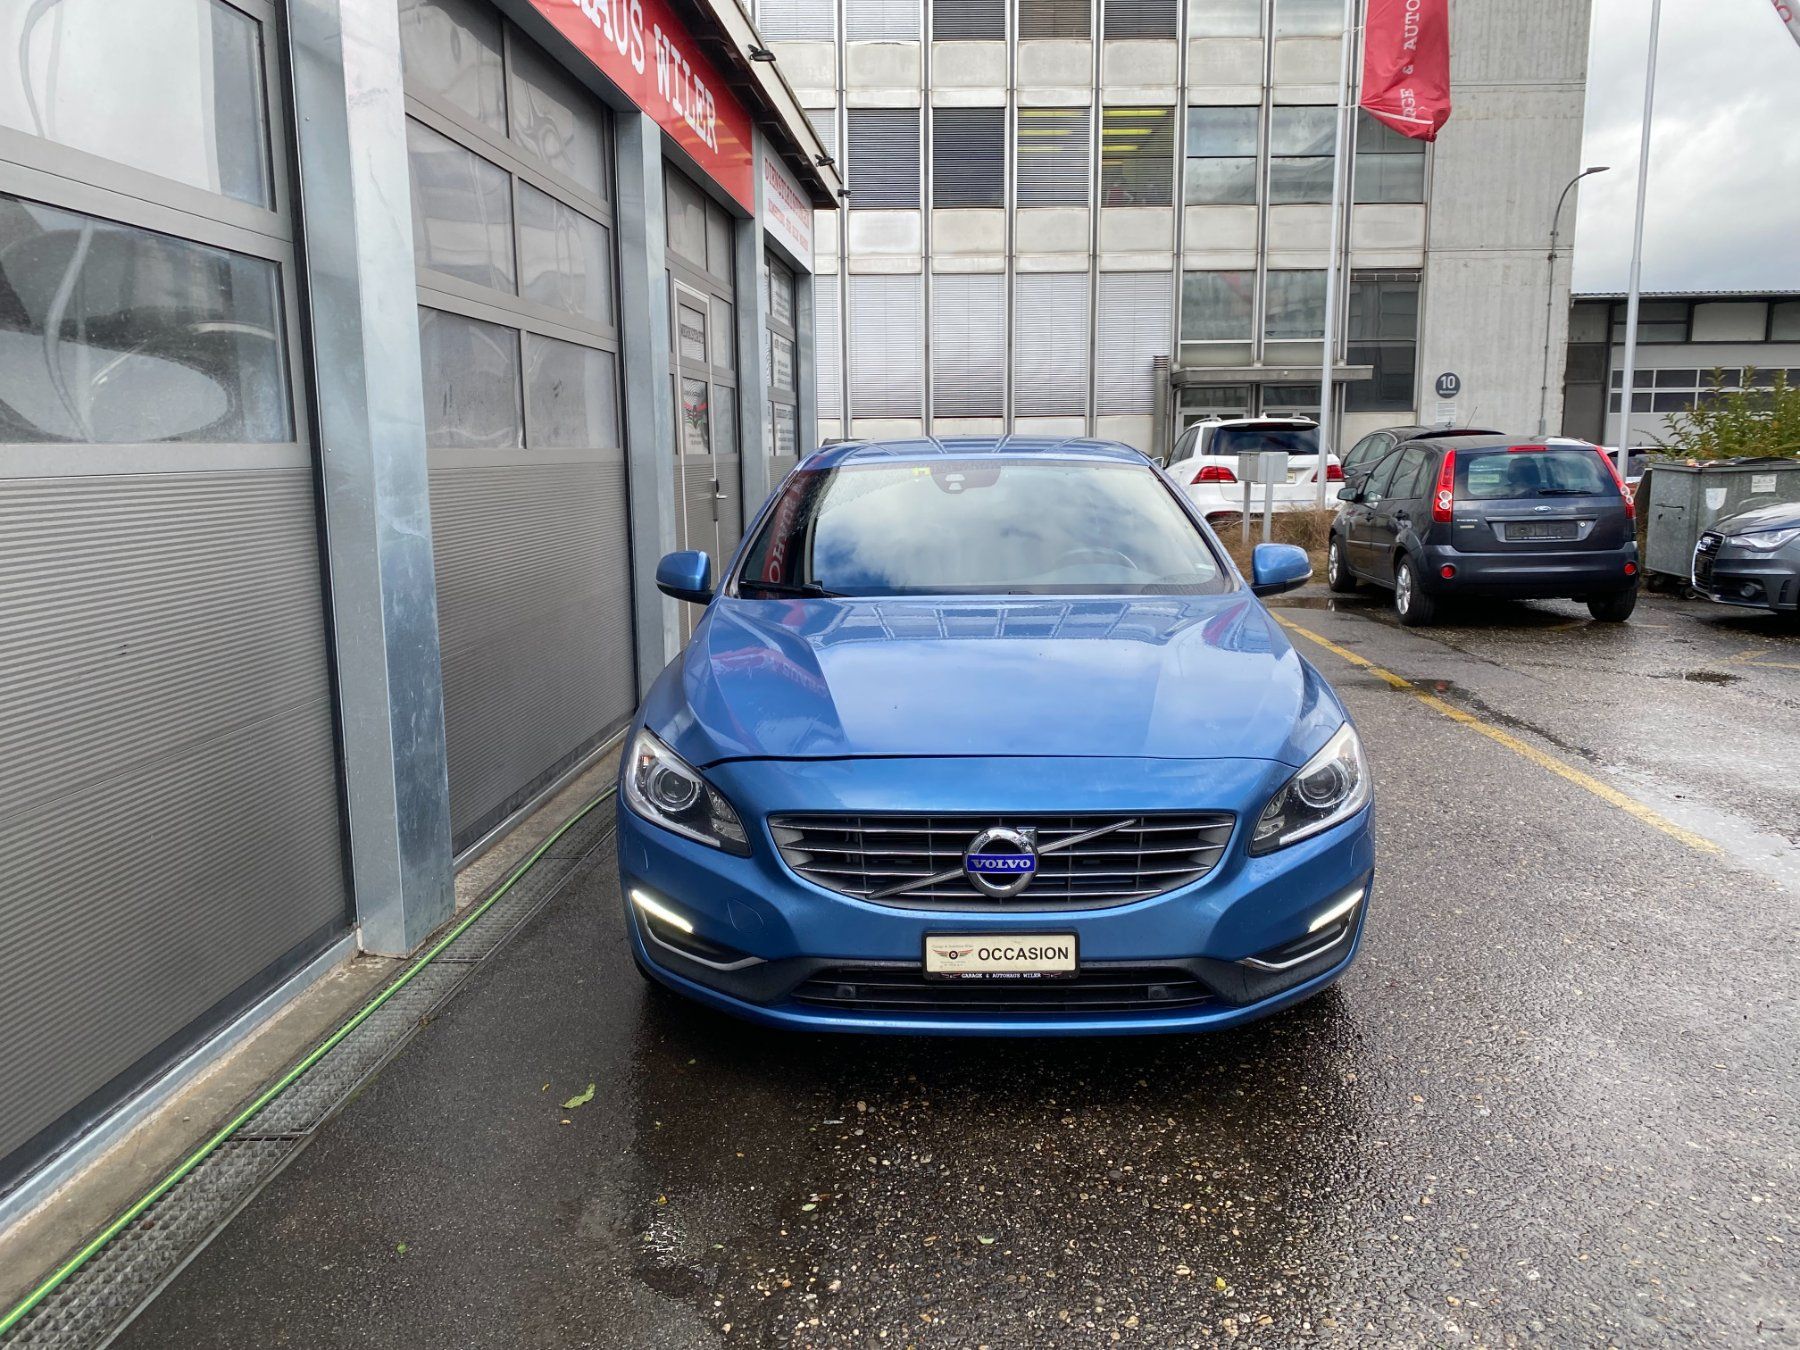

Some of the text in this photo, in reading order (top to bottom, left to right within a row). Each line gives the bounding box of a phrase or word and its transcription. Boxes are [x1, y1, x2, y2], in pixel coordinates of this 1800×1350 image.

[653, 24, 719, 154] WILER
[1440, 375, 1456, 389] 10
[971, 859, 1031, 869] VOLVO
[978, 947, 1069, 961] OCCASION
